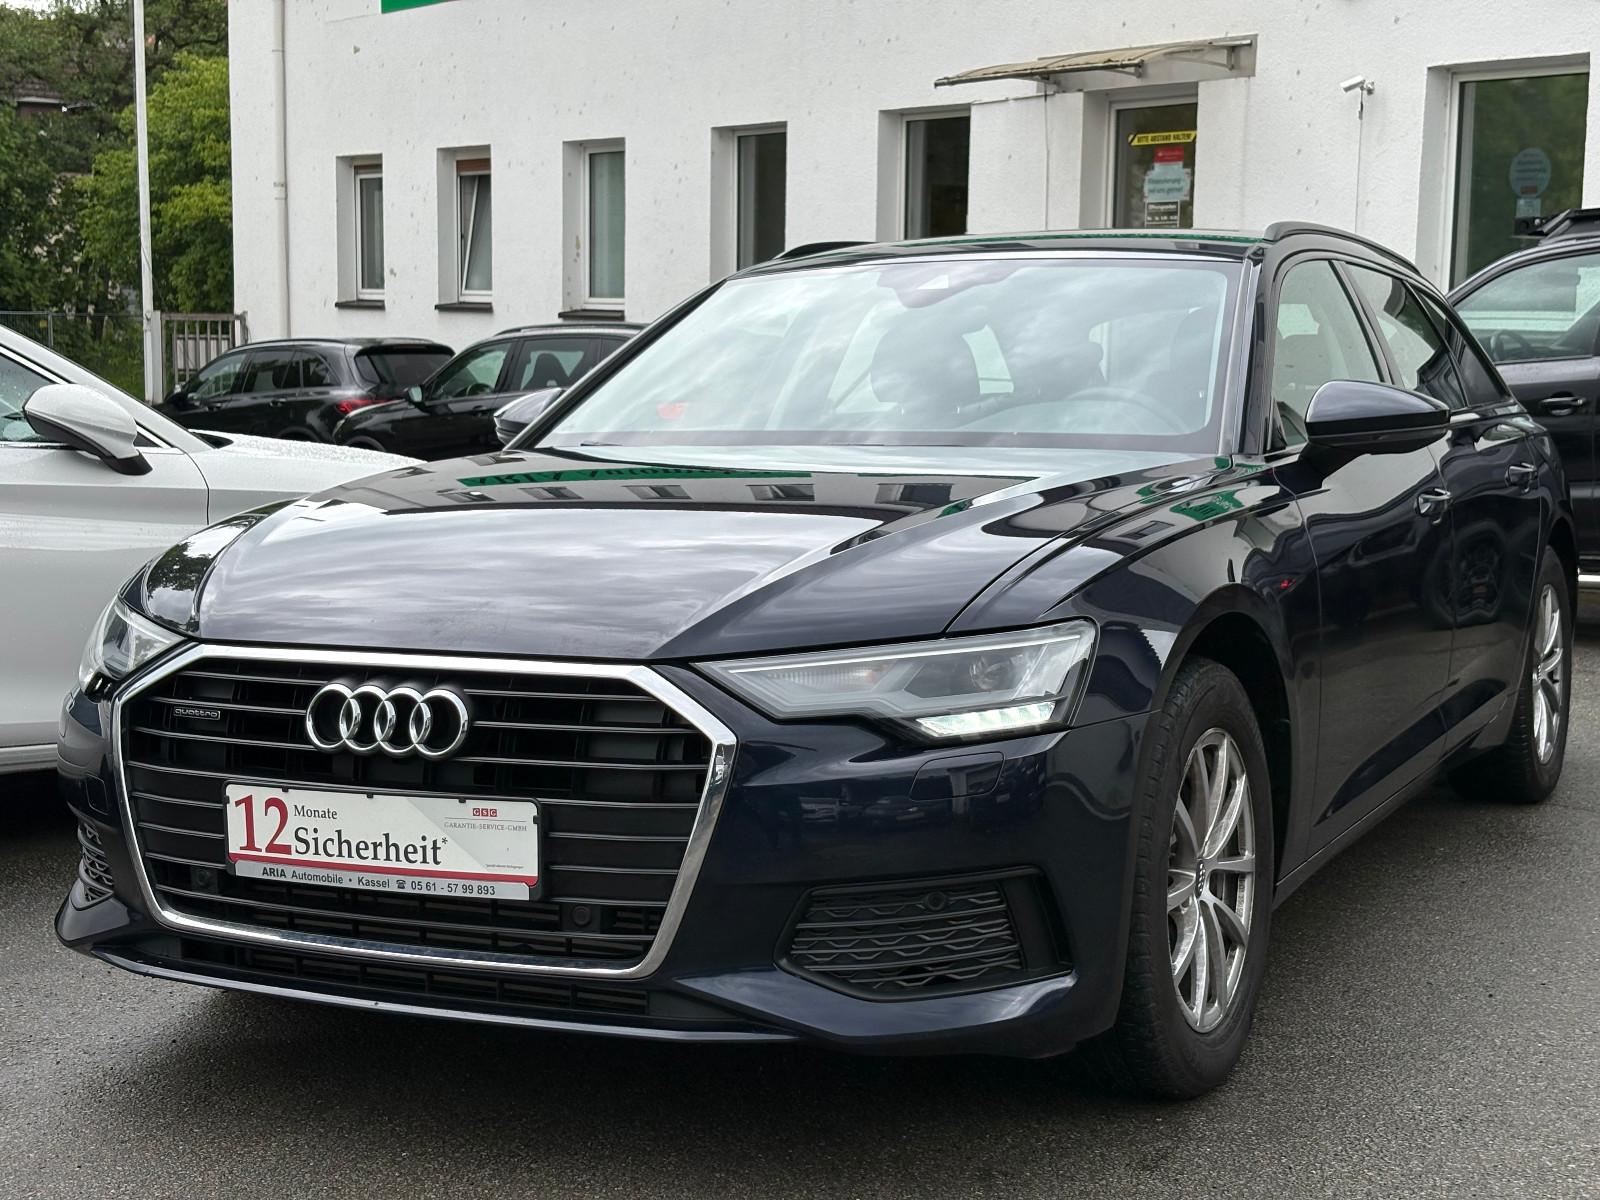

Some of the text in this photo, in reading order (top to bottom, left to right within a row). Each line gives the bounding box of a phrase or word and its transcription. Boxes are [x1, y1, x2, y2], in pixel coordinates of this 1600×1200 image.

[174, 708, 218, 718] quattro
[293, 804, 338, 820] Monate
[472, 807, 498, 818] GSG
[234, 794, 292, 856] 12
[262, 866, 287, 879] ARIA
[291, 870, 344, 884] Automobile
[357, 876, 390, 889] Kassel
[410, 880, 423, 891] 05
[425, 881, 437, 892] 61
[447, 882, 459, 893] 57
[461, 884, 474, 894] 99
[477, 885, 496, 896] 893
